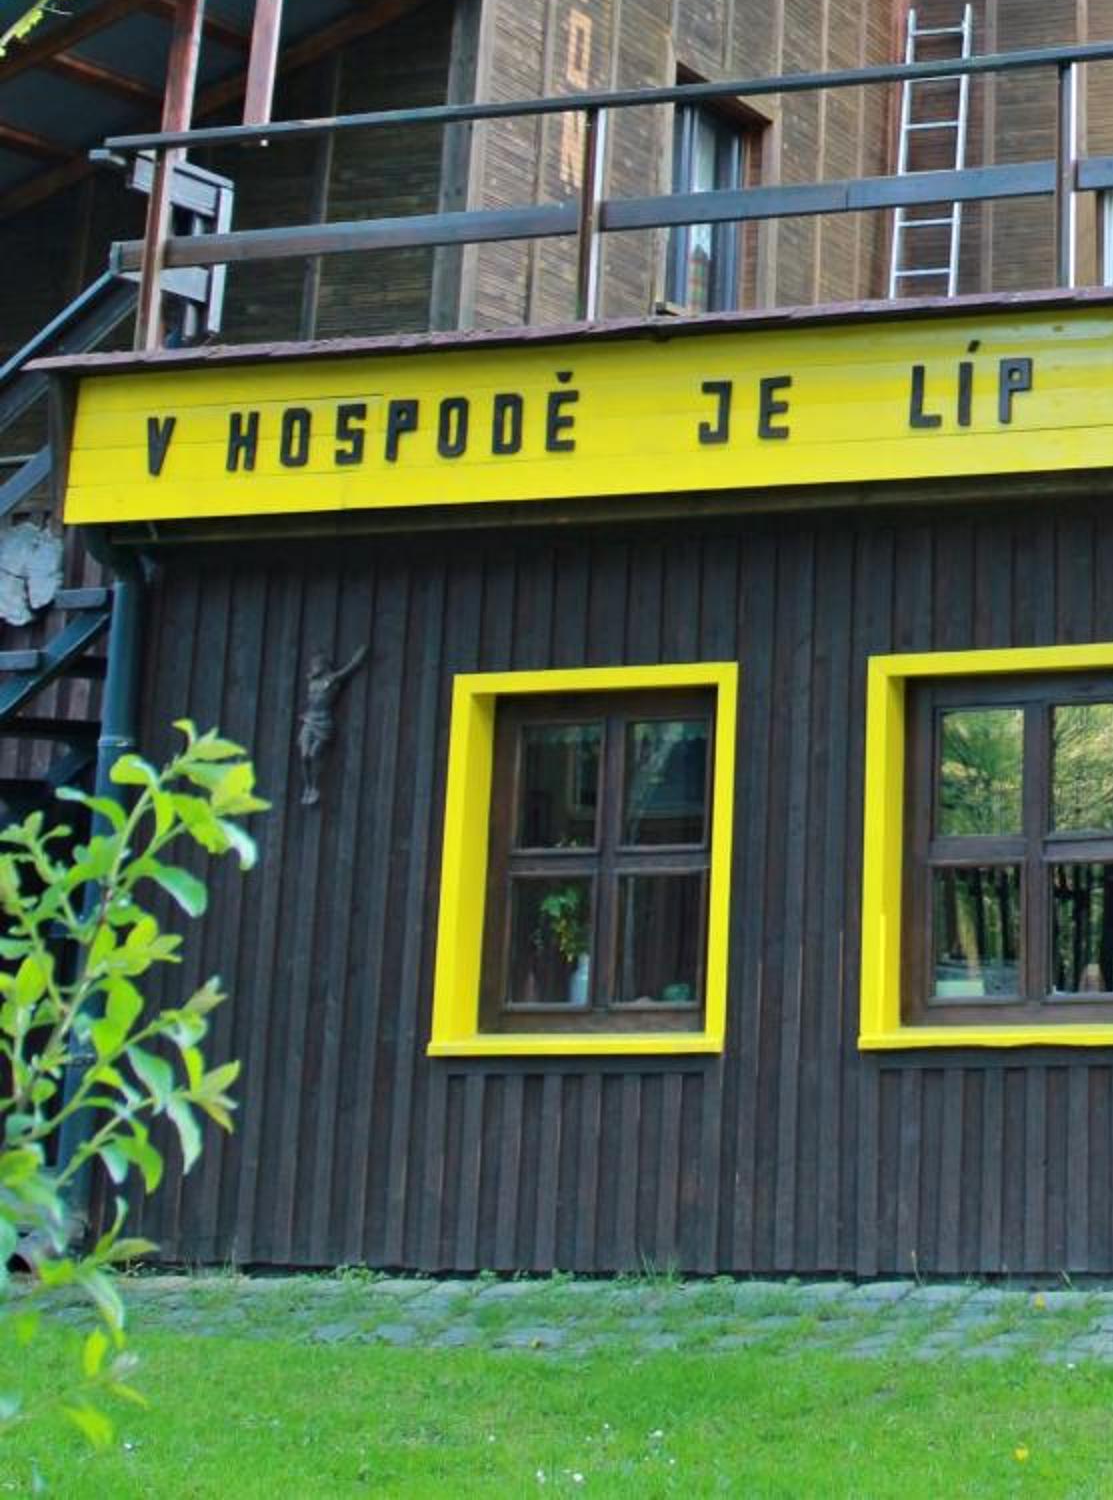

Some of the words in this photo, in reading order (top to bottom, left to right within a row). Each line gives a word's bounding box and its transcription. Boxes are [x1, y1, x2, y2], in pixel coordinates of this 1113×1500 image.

[147, 416, 177, 476] V
[226, 371, 579, 472] HOSPODĚ
[698, 375, 793, 444] JE
[909, 339, 1033, 428] LÍP
